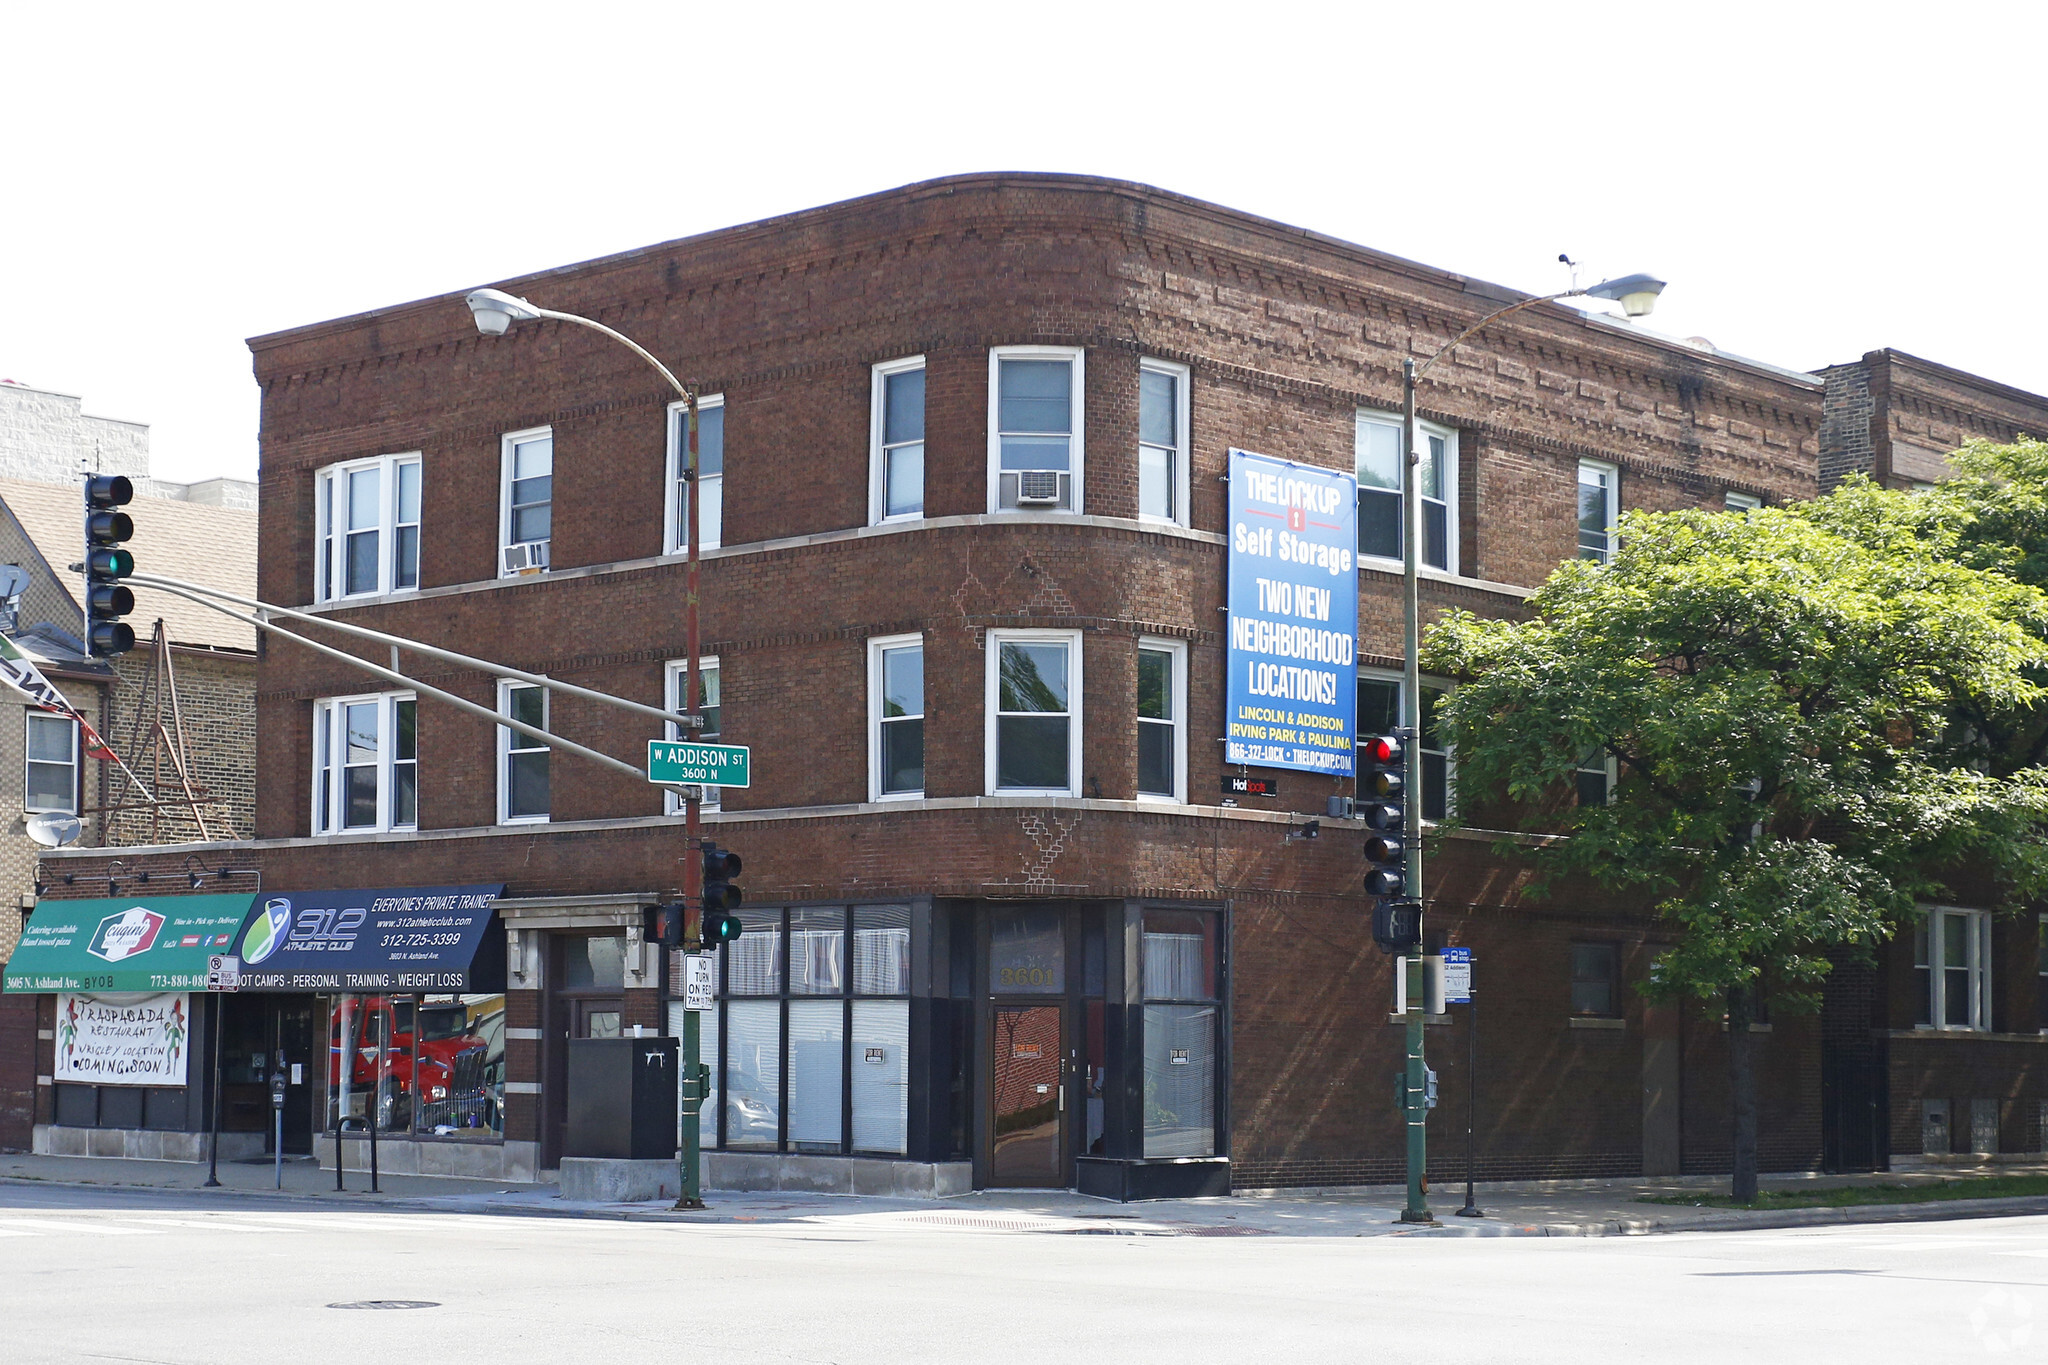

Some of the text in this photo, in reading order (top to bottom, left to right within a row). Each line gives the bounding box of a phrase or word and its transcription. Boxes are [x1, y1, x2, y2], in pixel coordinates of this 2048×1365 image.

[1245, 470, 1341, 515] THE LOCK UP
[1235, 522, 1351, 576] Self Storage
[1256, 577, 1331, 622] TWO NEW
[1232, 616, 1353, 666] NEIGHBORHOOD
[1248, 661, 1337, 706] LOCATIONS!
[1238, 705, 1344, 732] LINCOLN & ADDISON
[1229, 722, 1352, 750] IRVING PARK & PAULINA
[654, 747, 744, 766] W ADDISON ST
[1229, 742, 1352, 770] 866-327-LOCK THELOCKUP.COM
[681, 767, 718, 780] 3600 N
[371, 896, 424, 912] EVERYONE'S
[422, 895, 459, 911] PRIVATE
[27, 925, 78, 935] Catering available
[217, 917, 239, 926] Delivery
[289, 908, 367, 940] 312
[376, 917, 473, 928] www.312athleticclub.com
[106, 921, 148, 944] cugini
[380, 933, 461, 947] 312-725-3399
[21, 938, 39, 947] Hand
[54, 937, 71, 948] pizza
[282, 941, 354, 951] ATHLETIC CLUB
[408, 952, 428, 960] Ashland
[695, 960, 710, 982] NO TURN
[1000, 967, 1055, 986] 3601
[6, 976, 80, 989] 3605 N. Ashland Ave.
[84, 976, 113, 989] BYOB
[150, 975, 208, 987] 773-880-080
[254, 974, 285, 987] CAMPS
[292, 974, 340, 987] PERSONAL
[345, 973, 389, 987] TRAINING
[397, 973, 436, 987] WEIGHT
[437, 973, 463, 986] LOSS
[688, 983, 712, 995] ON RED
[78, 998, 165, 1024] TRASPASADA
[90, 1024, 155, 1039] RESTAURANT
